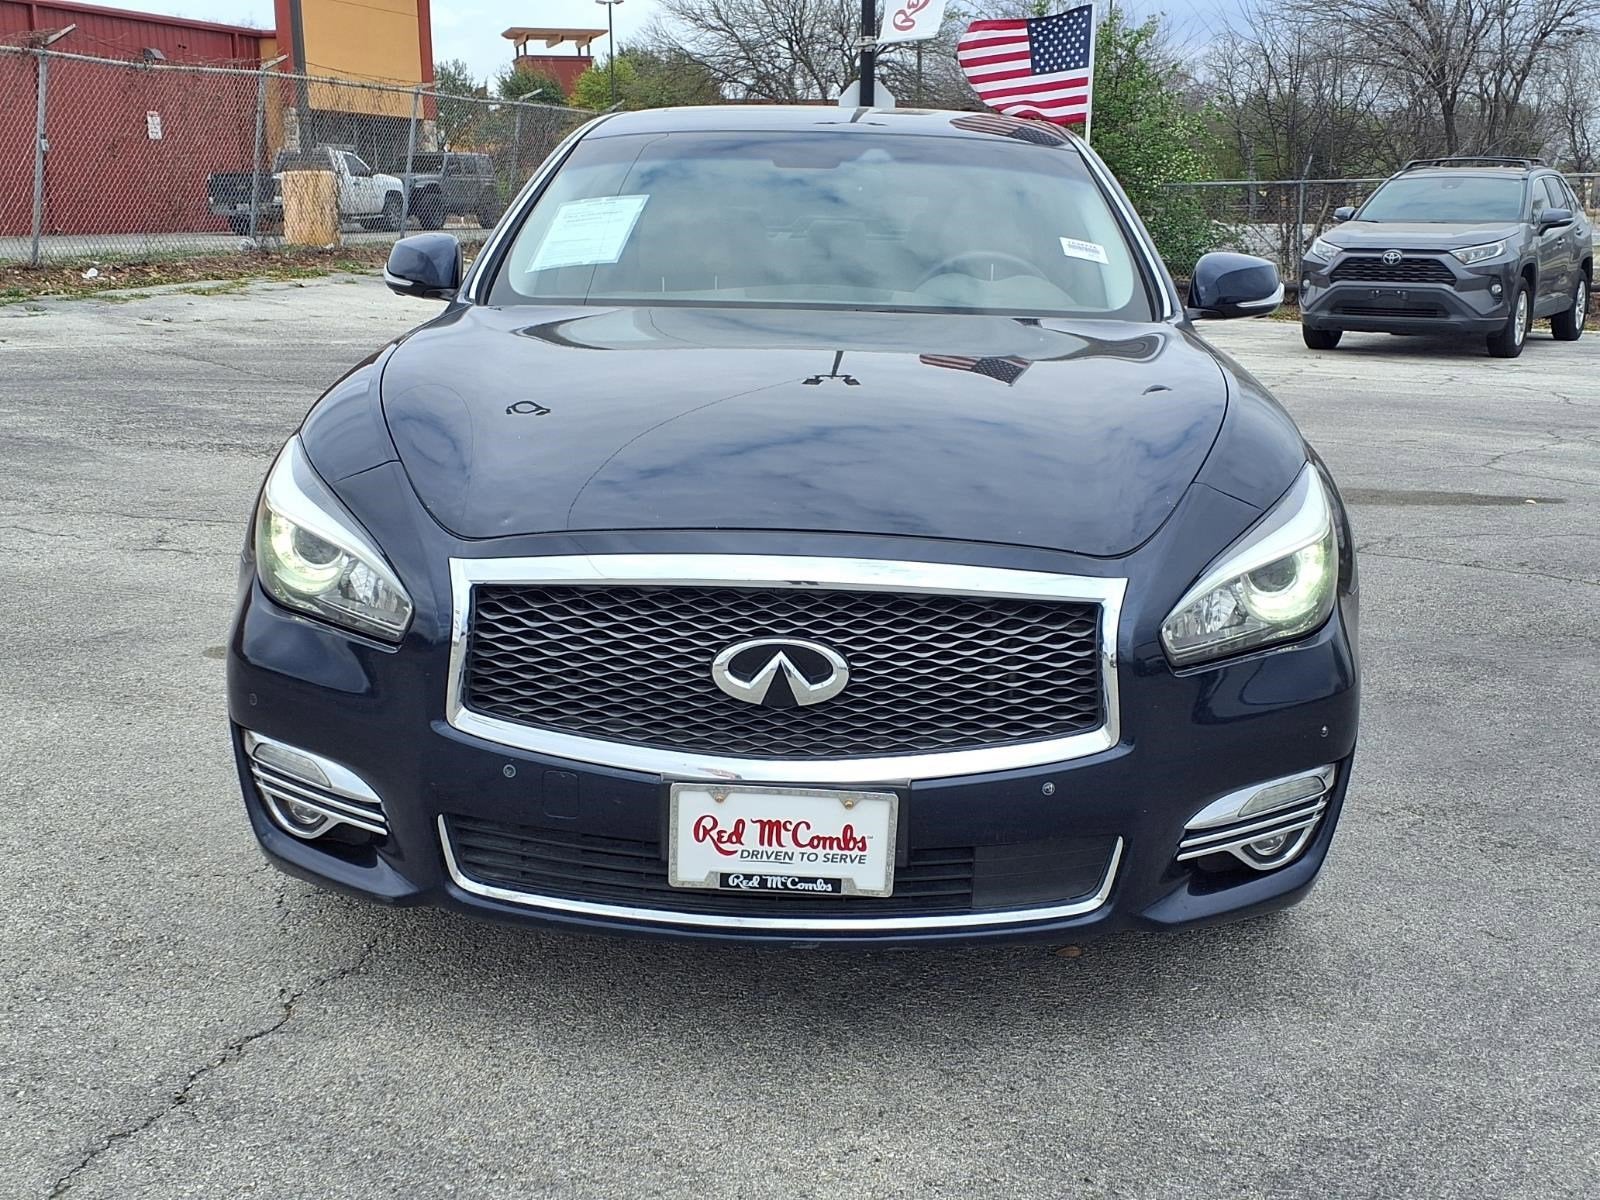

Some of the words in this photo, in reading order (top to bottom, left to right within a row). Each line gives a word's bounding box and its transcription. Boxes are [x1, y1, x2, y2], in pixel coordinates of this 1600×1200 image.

[693, 814, 746, 857] Red
[750, 818, 868, 852] McCombs
[739, 850, 795, 862] DRIVEN
[799, 852, 819, 863] TO
[822, 852, 867, 864] SERVE
[728, 873, 760, 889] Red
[762, 875, 833, 892] McCombs
